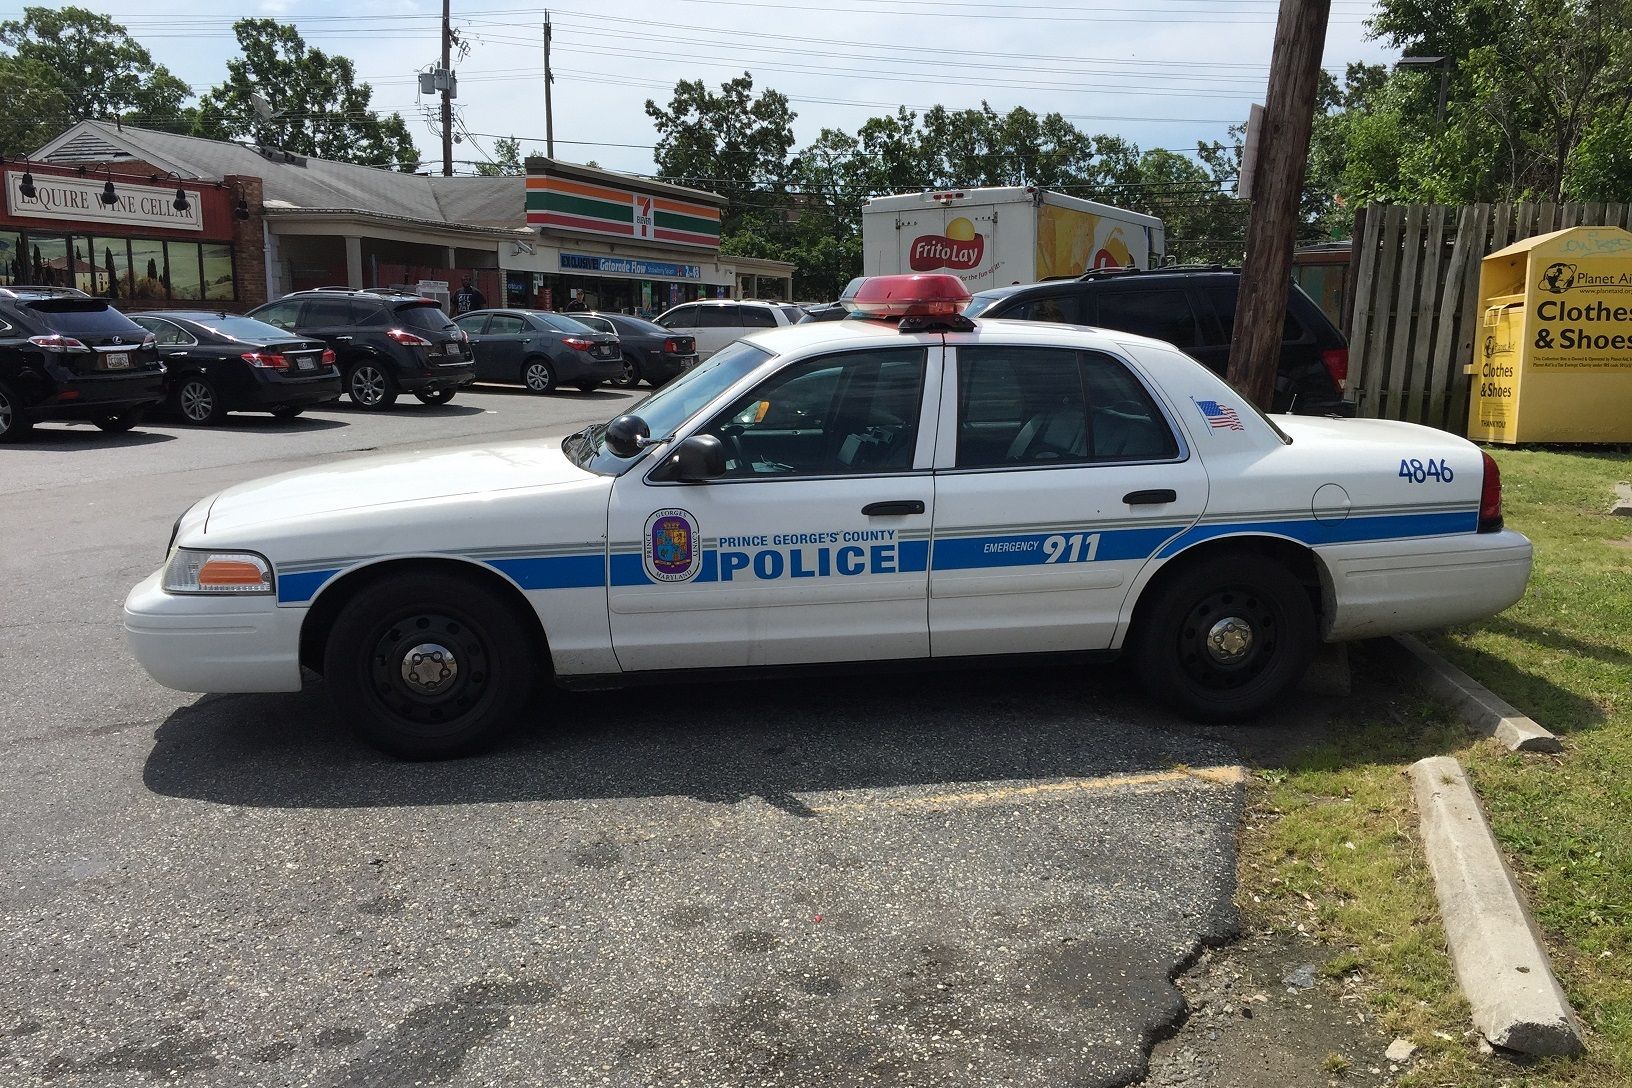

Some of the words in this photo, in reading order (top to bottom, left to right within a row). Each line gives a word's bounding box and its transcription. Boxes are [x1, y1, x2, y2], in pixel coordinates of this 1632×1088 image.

[599, 258, 630, 273] Gatorade
[631, 261, 647, 274] Flow
[1577, 272, 1614, 284] Planet
[1618, 272, 1632, 284] Ai
[1534, 328, 1555, 350] &
[1482, 362, 1514, 378] Clothes
[1398, 458, 1454, 484] 4846
[720, 535, 768, 548] PRINCE
[773, 532, 838, 546] GEORGE'S
[843, 529, 896, 543] COUNTY
[983, 540, 1040, 553] EMERGENCY
[1042, 533, 1101, 564] 911
[720, 544, 896, 582] POLICE
[656, 569, 692, 581] MARYLAND
